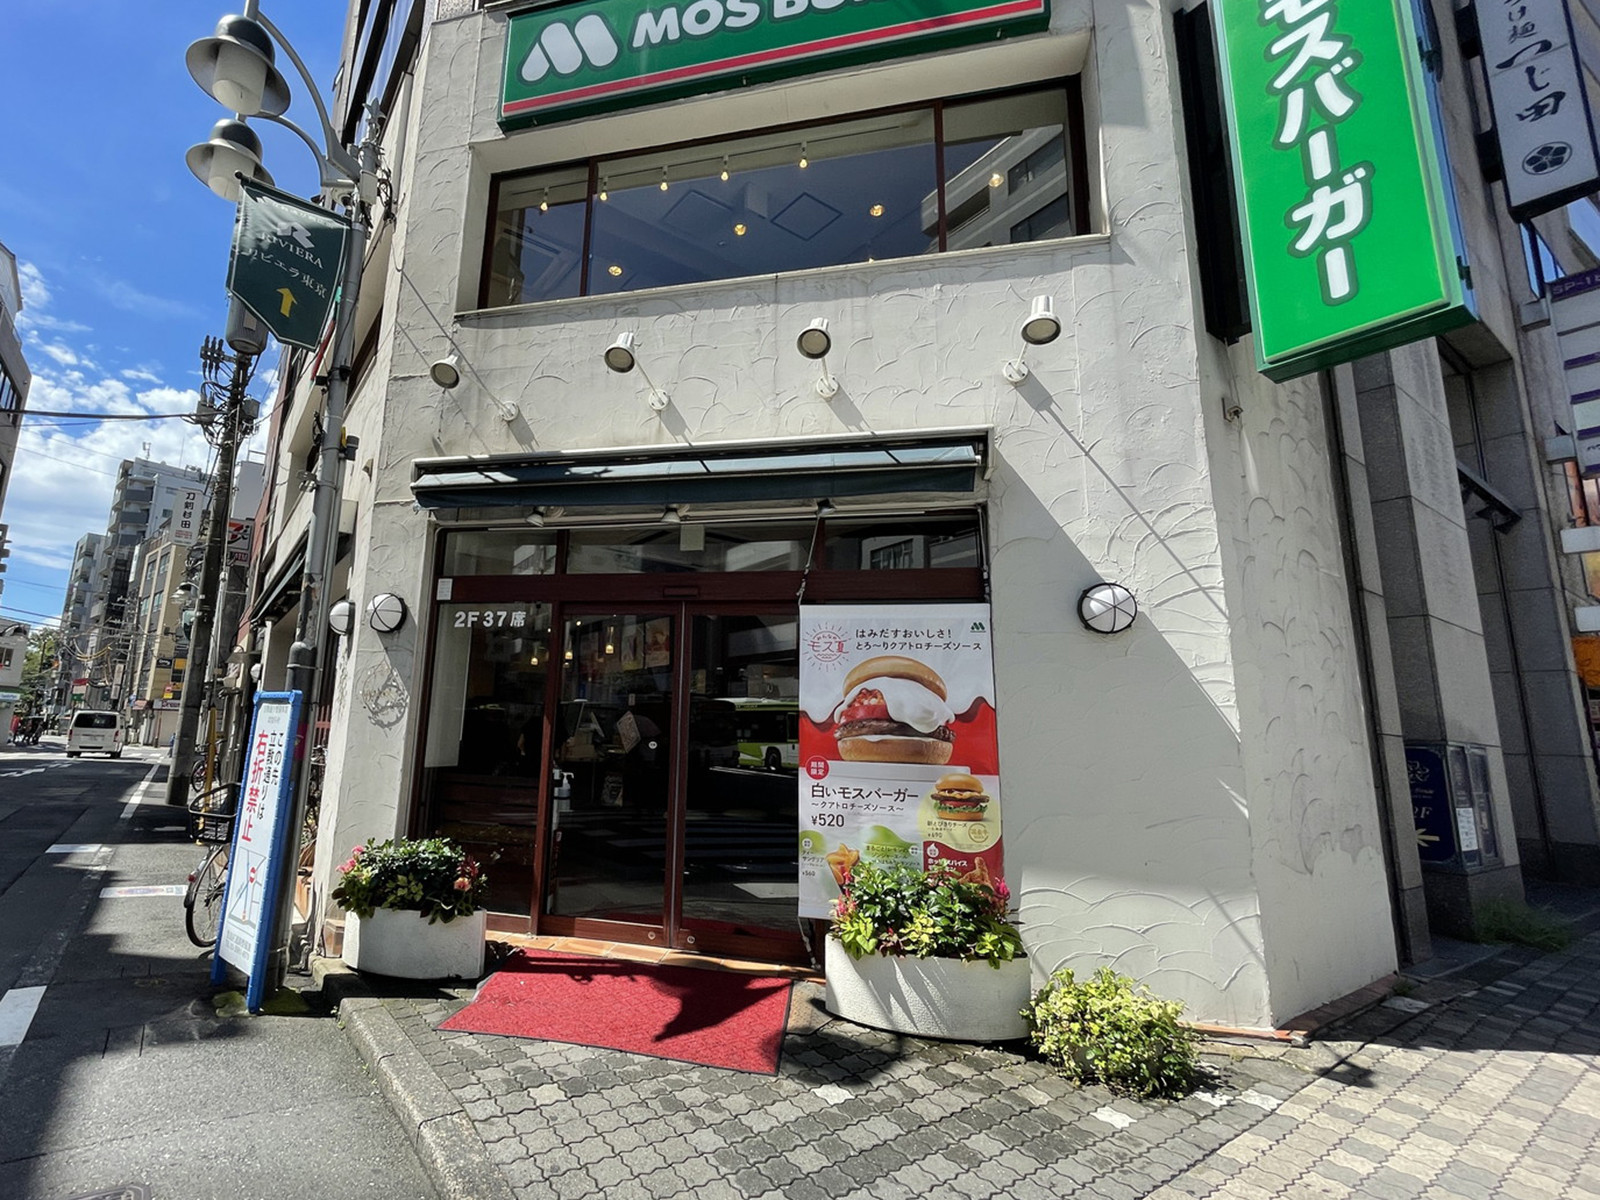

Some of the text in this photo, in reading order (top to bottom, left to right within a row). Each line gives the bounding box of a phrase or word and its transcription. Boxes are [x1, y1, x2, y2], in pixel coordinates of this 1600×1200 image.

[632, 0, 760, 48] MOS
[1503, 0, 1539, 44] け麺
[257, 231, 324, 270] RIVIERA
[241, 729, 269, 842] 右折禁止
[811, 782, 919, 803] 白いモスバーガー
[811, 813, 845, 828] ¥520
